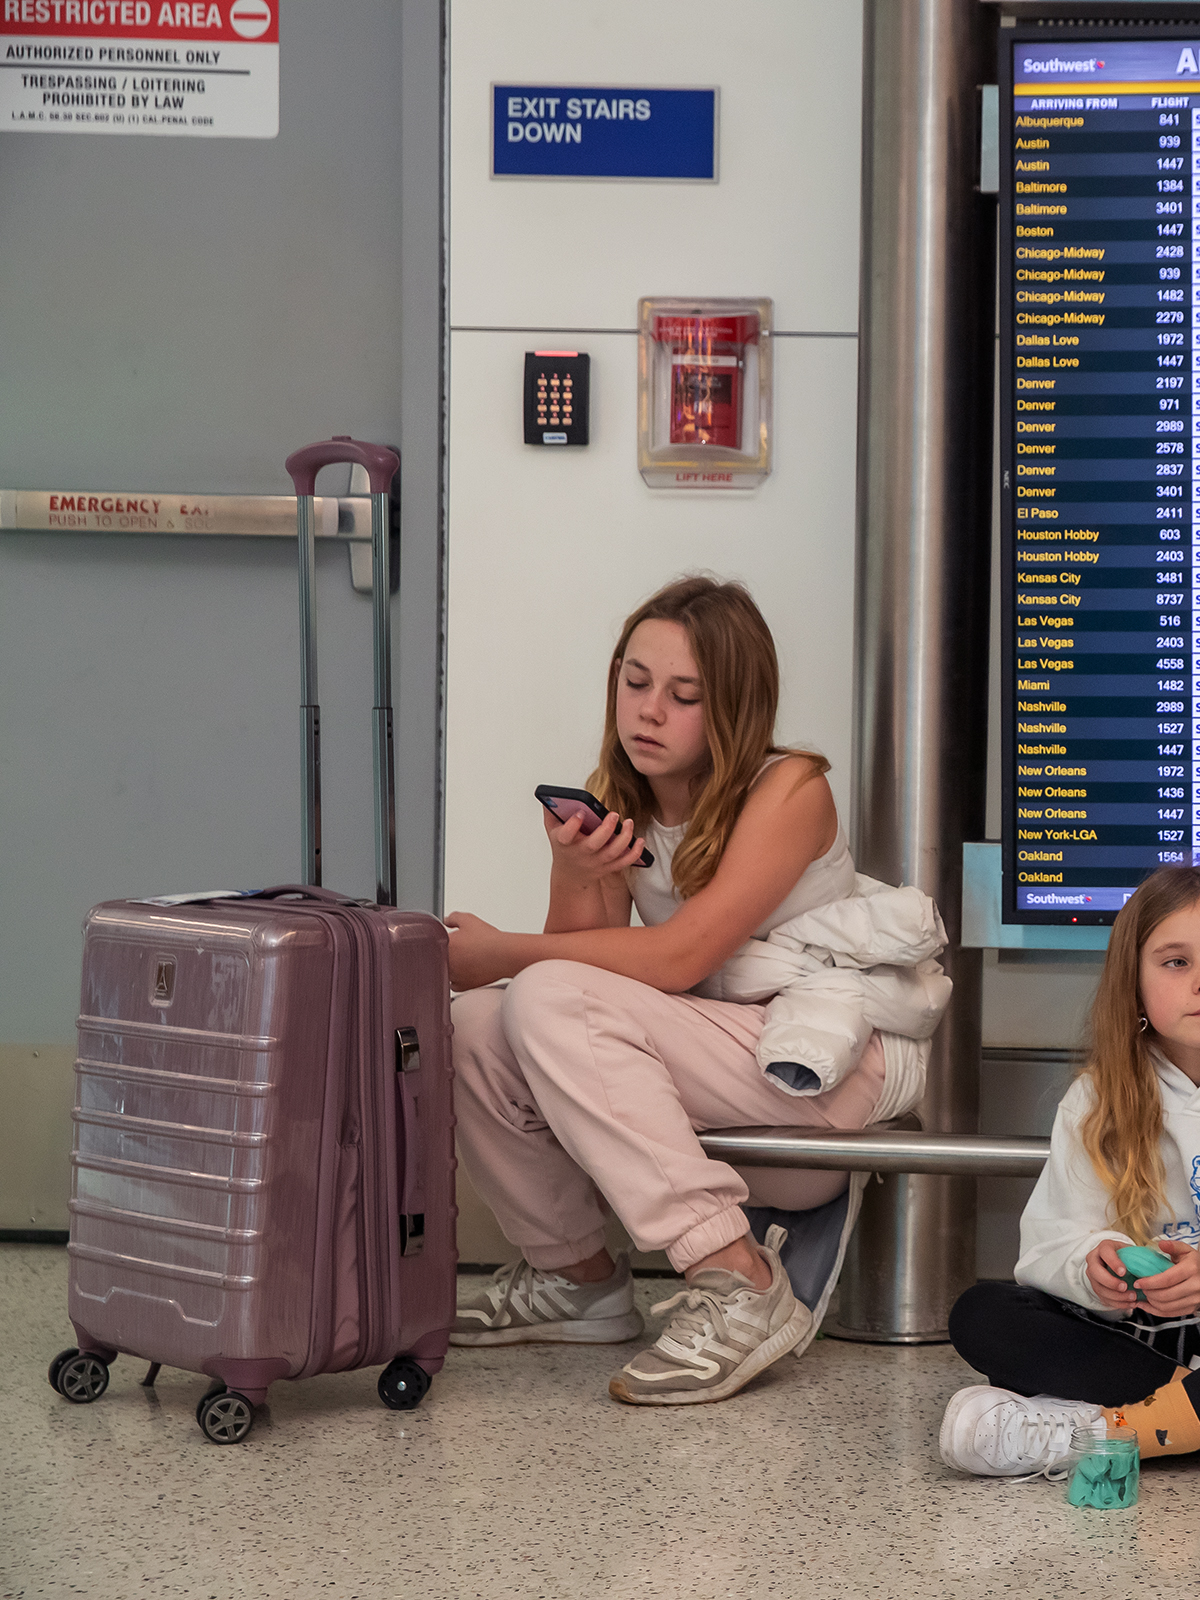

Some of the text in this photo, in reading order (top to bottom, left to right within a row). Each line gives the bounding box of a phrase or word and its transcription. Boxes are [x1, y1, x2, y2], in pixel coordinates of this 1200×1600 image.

[5, 0, 222, 28] RESTRICTED AREA
[6, 44, 220, 65] AUTHORIZED PERSONNEL ONLY
[1023, 57, 1096, 73] Southwest
[22, 74, 206, 93] TRESPASSING / LOITERING
[43, 94, 184, 109] PROHIBITED BY LAW
[1031, 98, 1083, 110] ARRIVING
[1085, 97, 1118, 109] FROM
[1152, 96, 1189, 109] FLIGHT
[507, 97, 651, 121] EXIT STAIRS
[192, 116, 214, 126] CODE
[1016, 114, 1084, 128] Albuquerque
[1159, 113, 1180, 126] 841
[507, 121, 582, 144] DOWN
[1016, 181, 1067, 193] Baltimore
[1156, 179, 1184, 192] 1384
[1017, 400, 1055, 411] Denver
[1159, 399, 1180, 411] 971
[676, 473, 733, 482] LIFT HERE
[49, 496, 161, 514] EMERGENCY
[1017, 508, 1027, 519] El
[1030, 508, 1058, 519] Paso
[1156, 507, 1183, 519] 2411
[49, 514, 87, 526] PUSH
[94, 516, 111, 527] TO
[120, 516, 157, 528] OPEN
[1018, 593, 1057, 605] Kansas
[1060, 593, 1081, 608] City
[1157, 594, 1183, 605] 8737
[1018, 680, 1050, 691] Miami
[1157, 680, 1183, 691] 1482
[1019, 786, 1043, 798] New
[1046, 786, 1087, 798] Orleans
[1157, 787, 1183, 799] 1436
[1019, 830, 1043, 841] New
[1046, 830, 1097, 841] York-LGA
[1157, 830, 1183, 842] 1527
[1019, 872, 1063, 883] Oakland
[1026, 892, 1085, 905] Southwest
